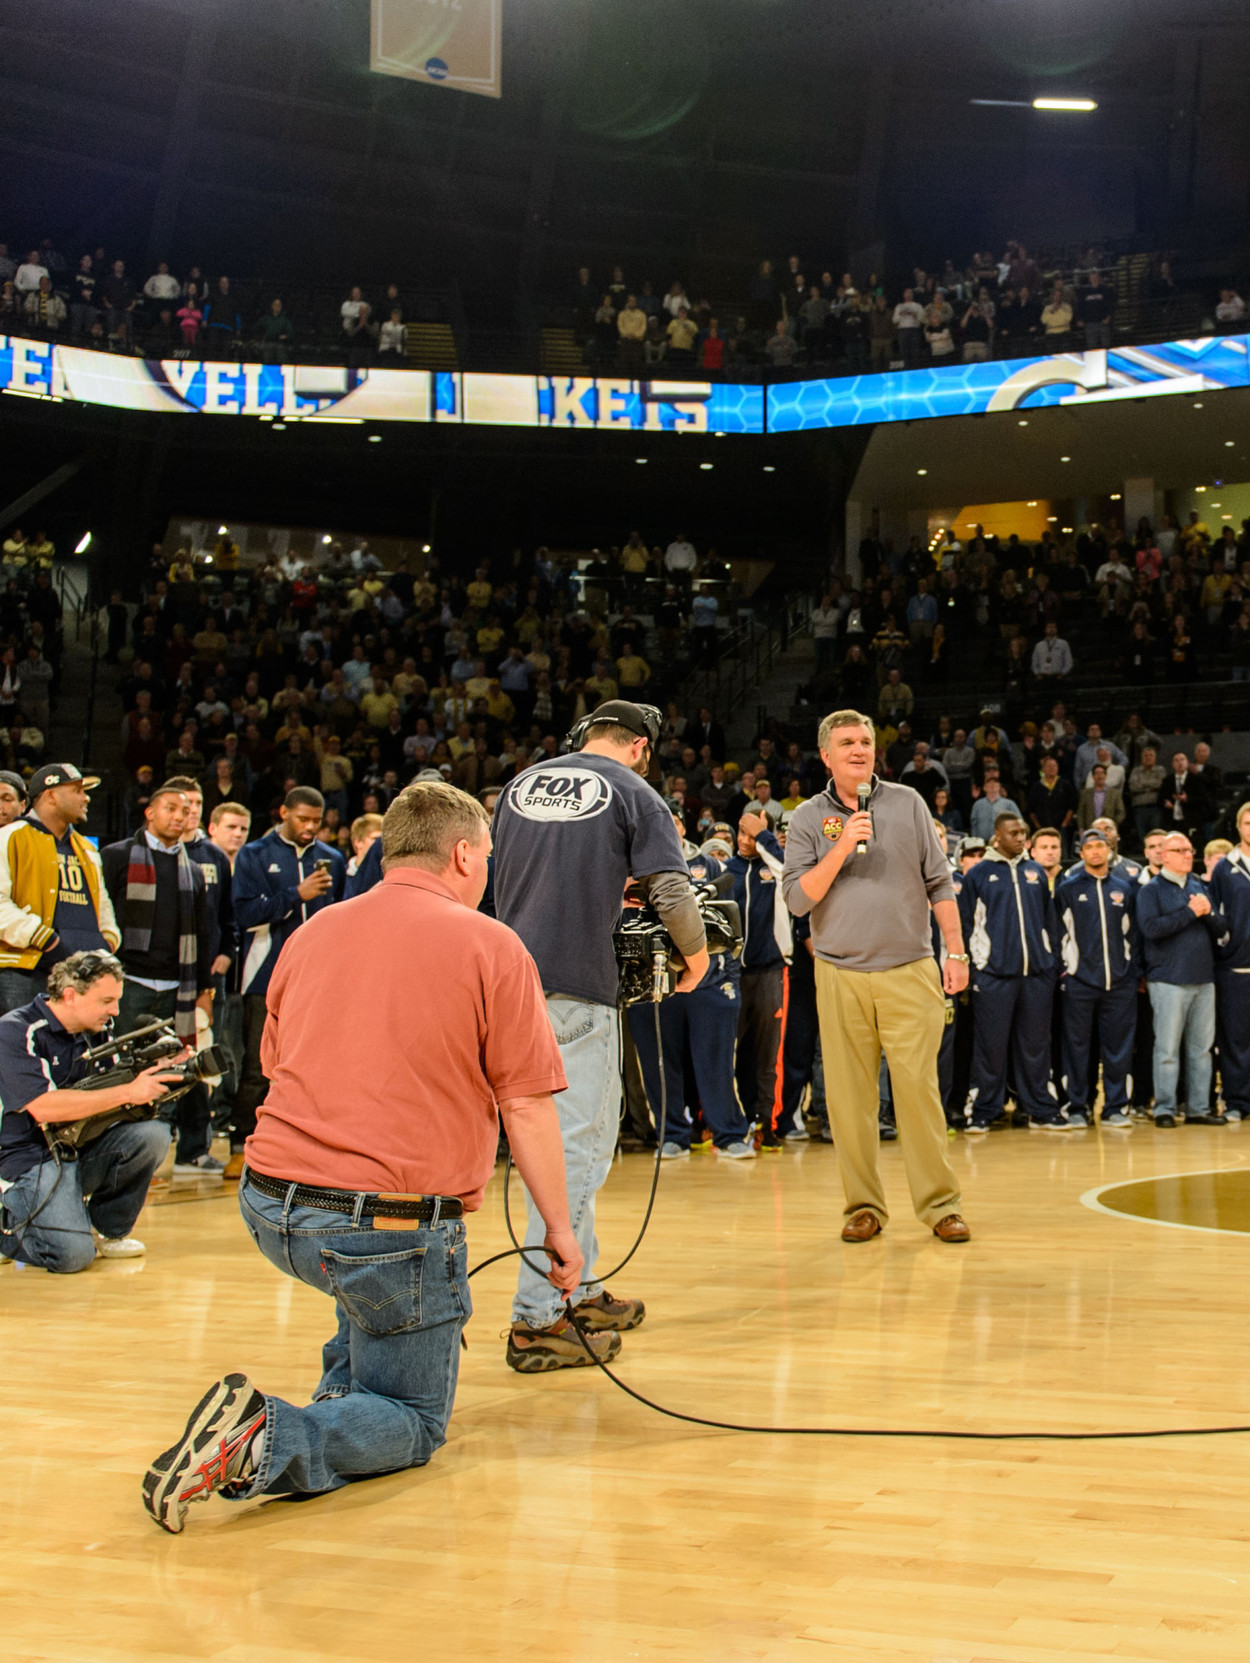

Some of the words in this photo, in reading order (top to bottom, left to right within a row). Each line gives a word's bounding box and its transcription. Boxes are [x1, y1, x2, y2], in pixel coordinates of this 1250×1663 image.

[527, 774, 593, 801] FOX
[523, 795, 582, 812] SPORTS
[824, 821, 842, 832] ACC
[58, 864, 83, 892] 10
[58, 889, 89, 906] FOOTBALL
